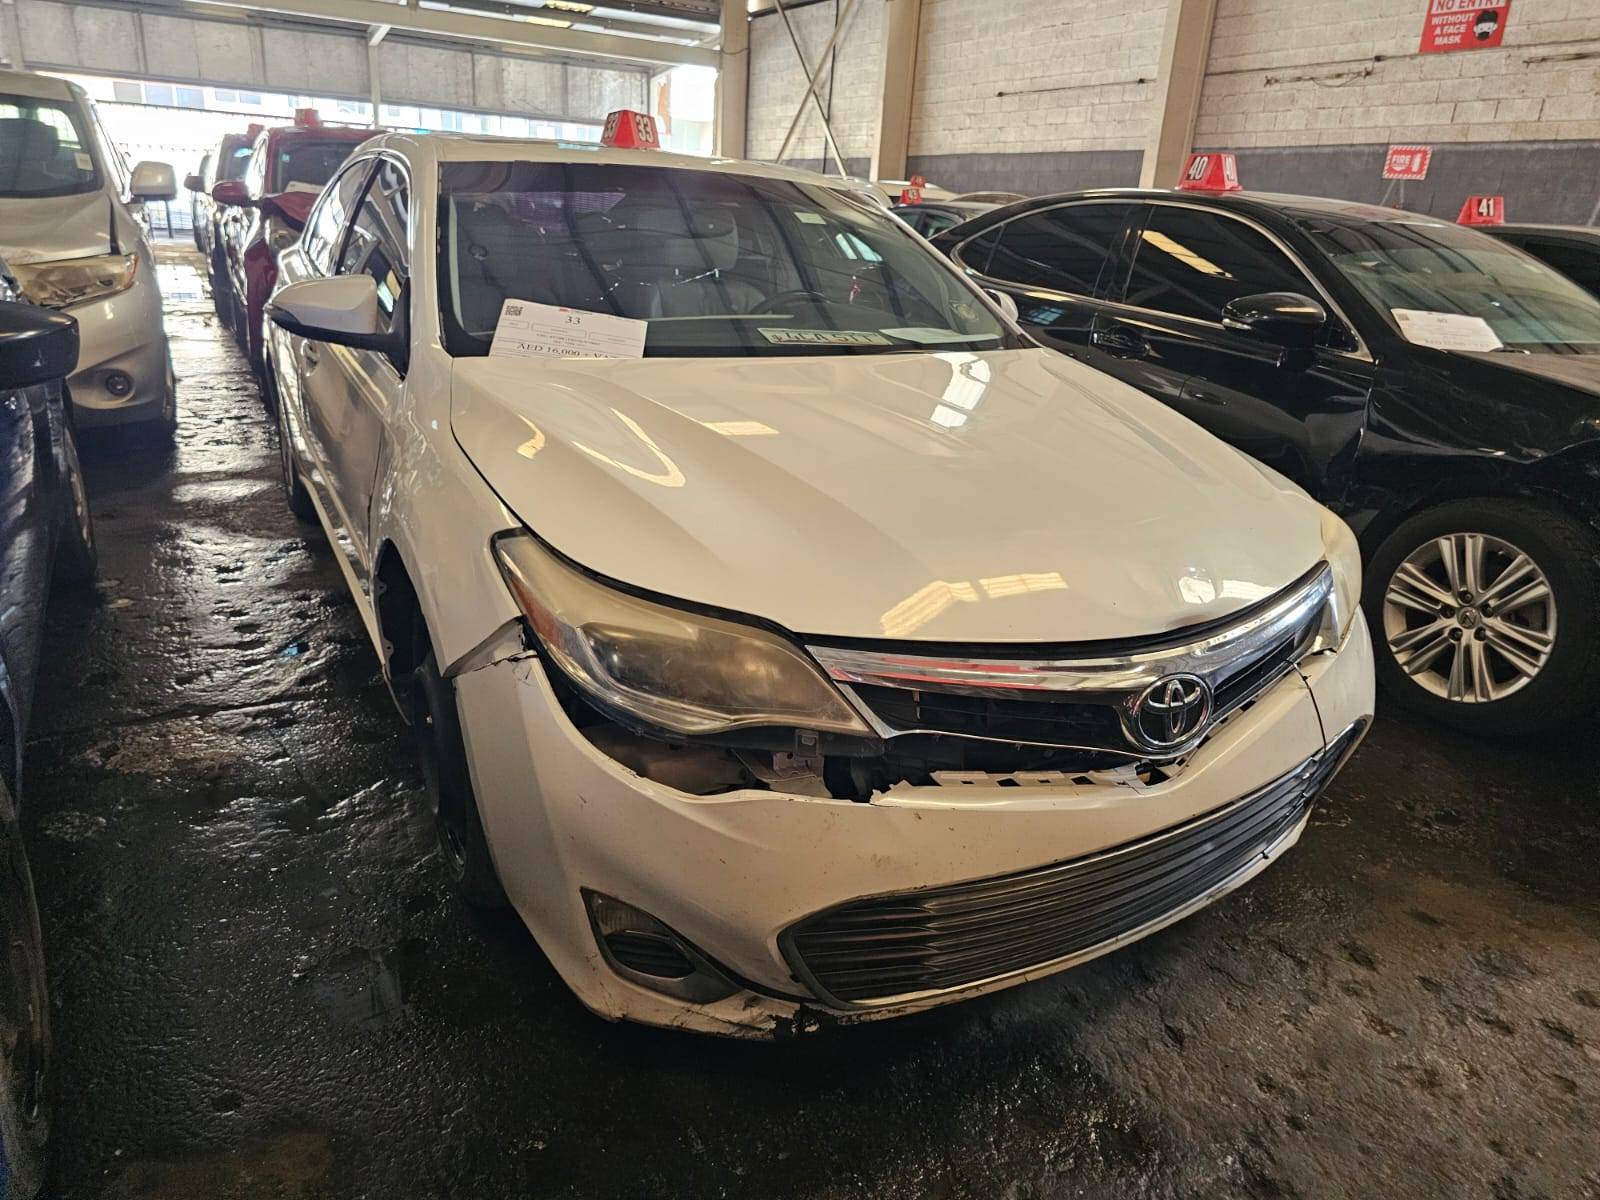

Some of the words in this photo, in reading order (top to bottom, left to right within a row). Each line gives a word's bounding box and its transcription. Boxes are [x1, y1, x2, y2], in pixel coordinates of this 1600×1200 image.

[1436, 0, 1455, 11] NO
[1432, 13, 1475, 25] WITHOUT
[1433, 26, 1441, 36] A
[1442, 24, 1467, 34] FACE
[1433, 35, 1462, 45] MASK
[636, 115, 654, 143] 33
[1188, 156, 1208, 180] 40
[1479, 198, 1494, 216] 41
[565, 316, 581, 325] 33
[516, 343, 543, 352] AED
[547, 346, 581, 358] 16,000
